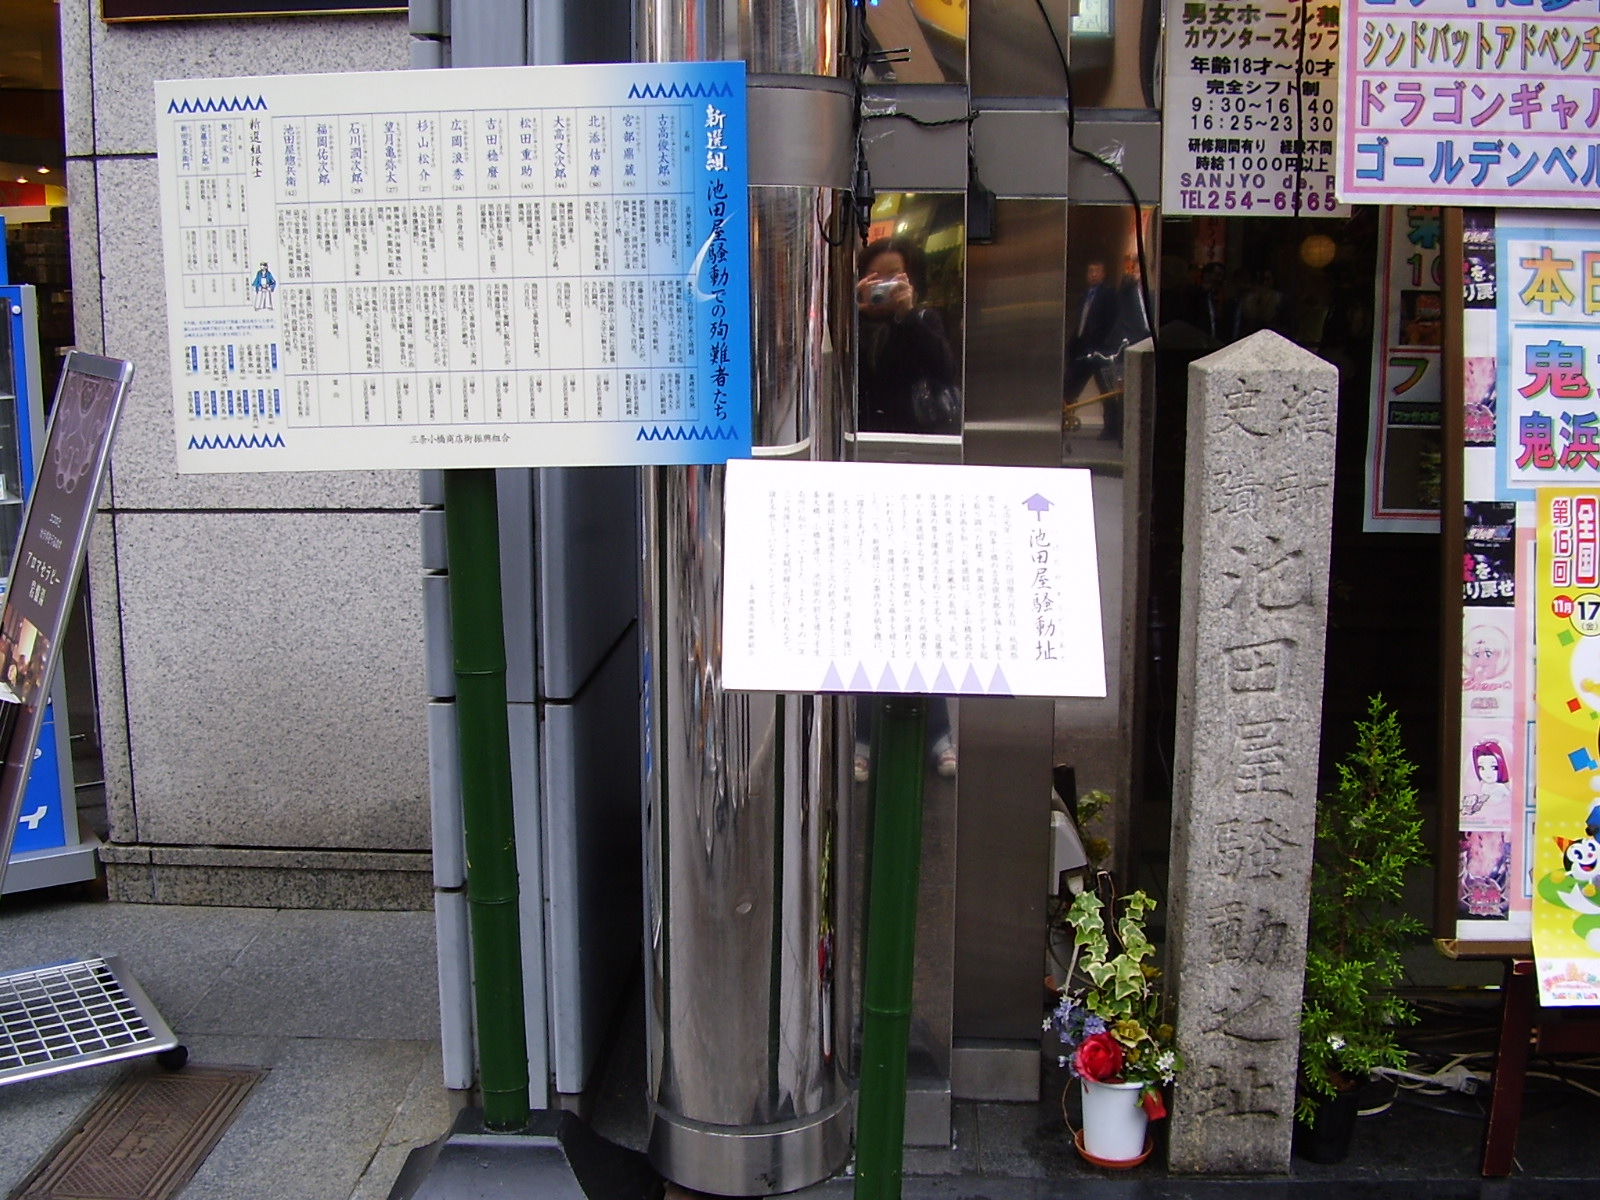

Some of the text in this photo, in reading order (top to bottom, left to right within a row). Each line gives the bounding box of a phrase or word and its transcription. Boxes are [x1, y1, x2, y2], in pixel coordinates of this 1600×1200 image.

[1185, 26, 1339, 50] カウンタースタッフ
[1206, 80, 1320, 96] 完全シフト制
[249, 118, 262, 178] 新選組隊士
[1188, 138, 1333, 155] 研修期間有り 経験不問
[1180, 173, 1266, 189] SANJYO
[704, 104, 731, 421] 新選組 池田屋騒動での殉難者たち
[410, 433, 510, 444] 三条小橋商店街振興組合
[1552, 499, 1570, 584] 第16回
[1029, 528, 1057, 659] 池田屋騒動址
[1553, 599, 1573, 614] 11月
[1578, 601, 1600, 621] 17
